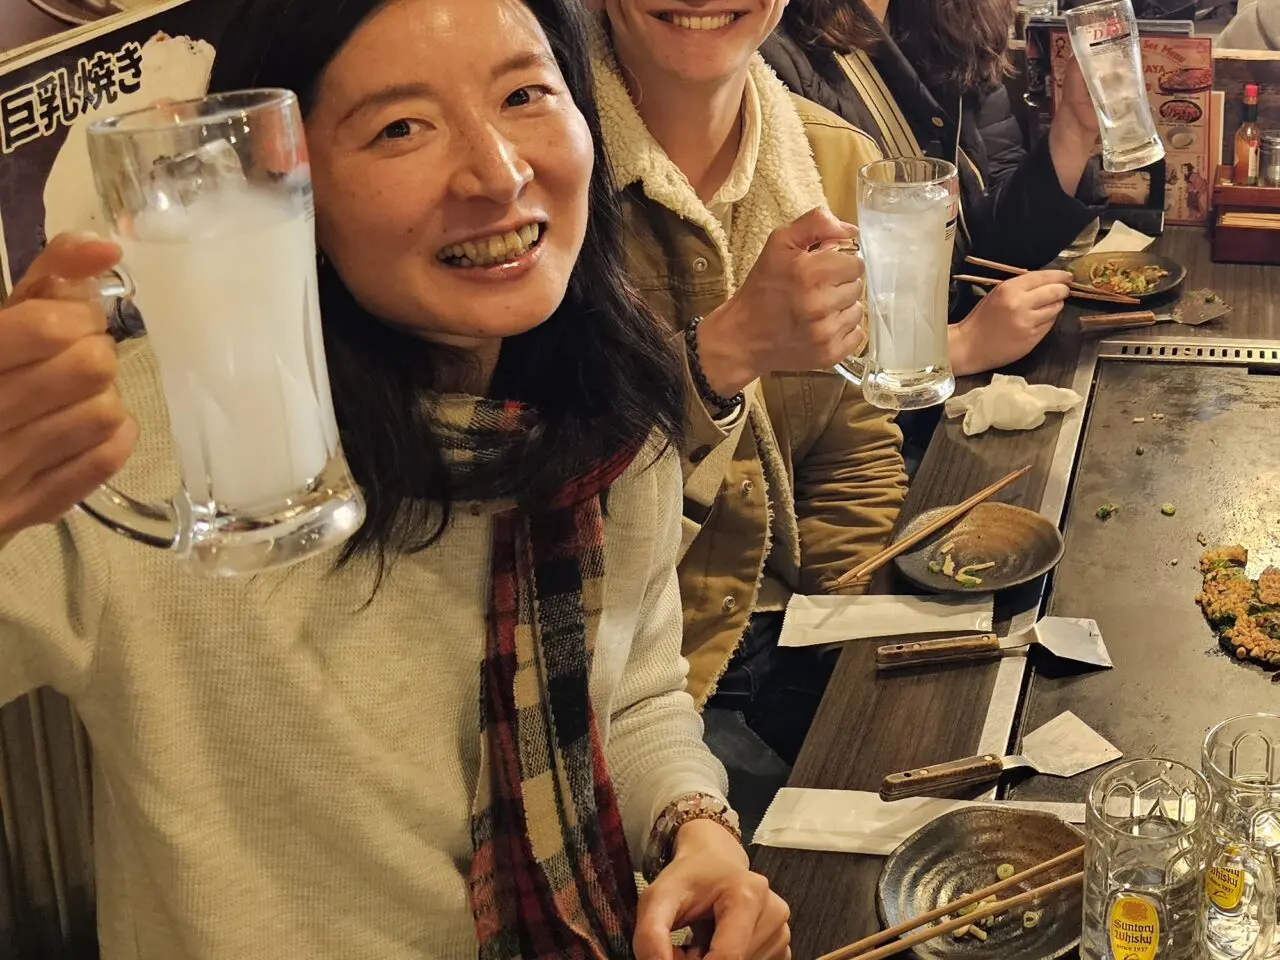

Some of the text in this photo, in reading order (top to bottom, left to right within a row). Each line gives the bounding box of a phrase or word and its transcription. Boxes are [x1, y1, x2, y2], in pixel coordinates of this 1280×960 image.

[1161, 45, 1186, 63] Menu
[0, 42, 143, 154] 巨乳焼き
[1113, 918, 1154, 934] Suntory
[1113, 929, 1152, 945] Whisky
